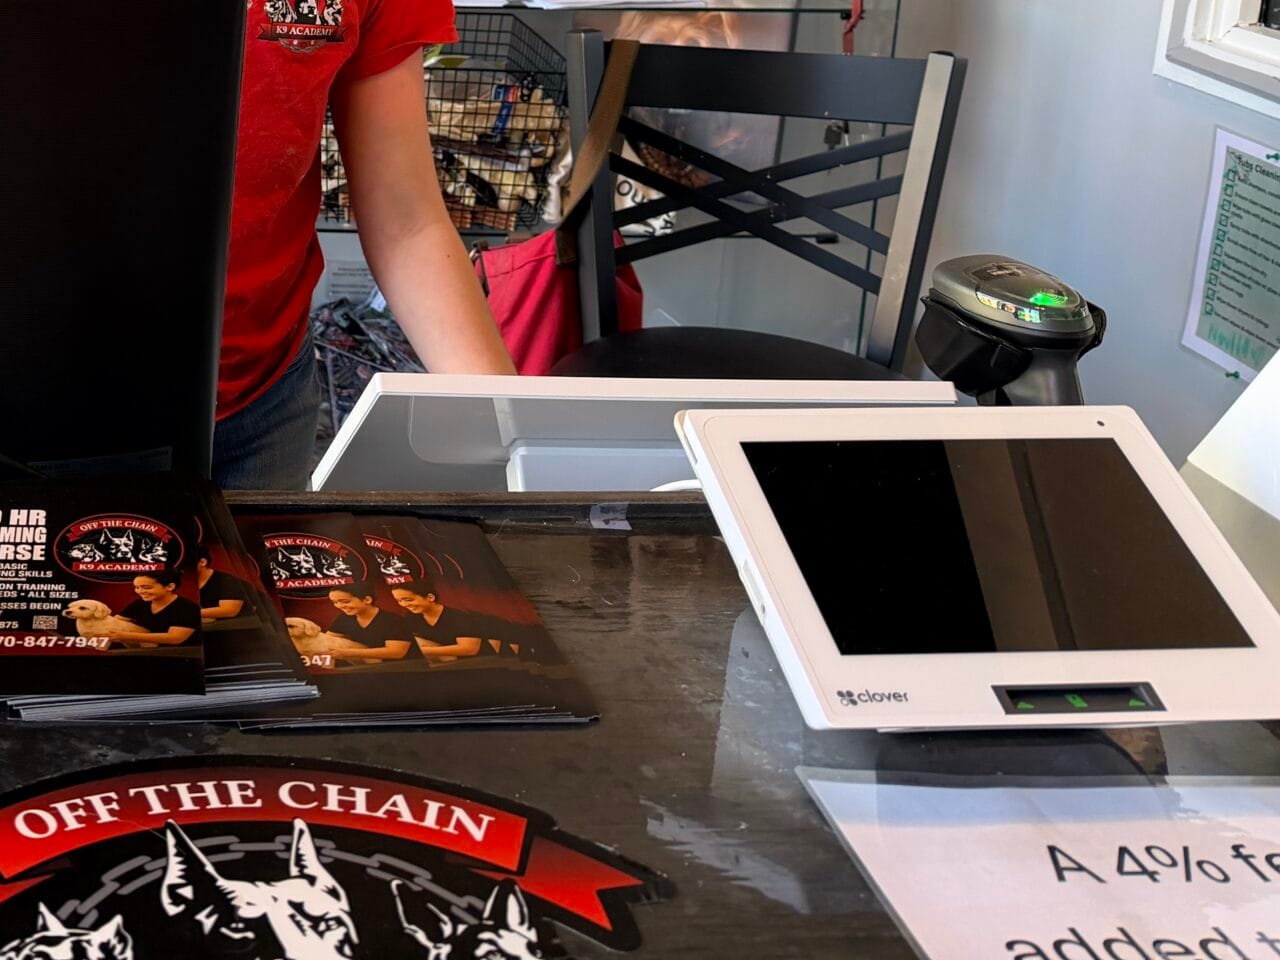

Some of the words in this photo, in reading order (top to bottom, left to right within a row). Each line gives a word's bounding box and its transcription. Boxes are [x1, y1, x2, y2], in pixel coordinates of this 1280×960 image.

[276, 25, 287, 34] K9
[289, 26, 333, 36] ACADEMY
[9, 509, 47, 526] HR
[79, 521, 100, 532] OFF
[100, 520, 122, 528] THE
[124, 520, 158, 532] CHAIN
[271, 538, 295, 547] THE
[296, 538, 332, 549] CHAIN
[97, 563, 158, 571] ACADEMY
[17, 570, 53, 578] SKILLS
[16, 583, 66, 591] TRAINING
[287, 578, 347, 588] ACADEMY
[49, 591, 79, 599] SIZES
[29, 602, 61, 610] BEGIN
[857, 689, 909, 703] clover
[14, 792, 121, 839] OFF
[129, 780, 263, 815] THE
[278, 780, 496, 842] CHAIN
[1047, 844, 1107, 884] A
[1116, 845, 1231, 884] 4%
[1005, 926, 1250, 960] added
